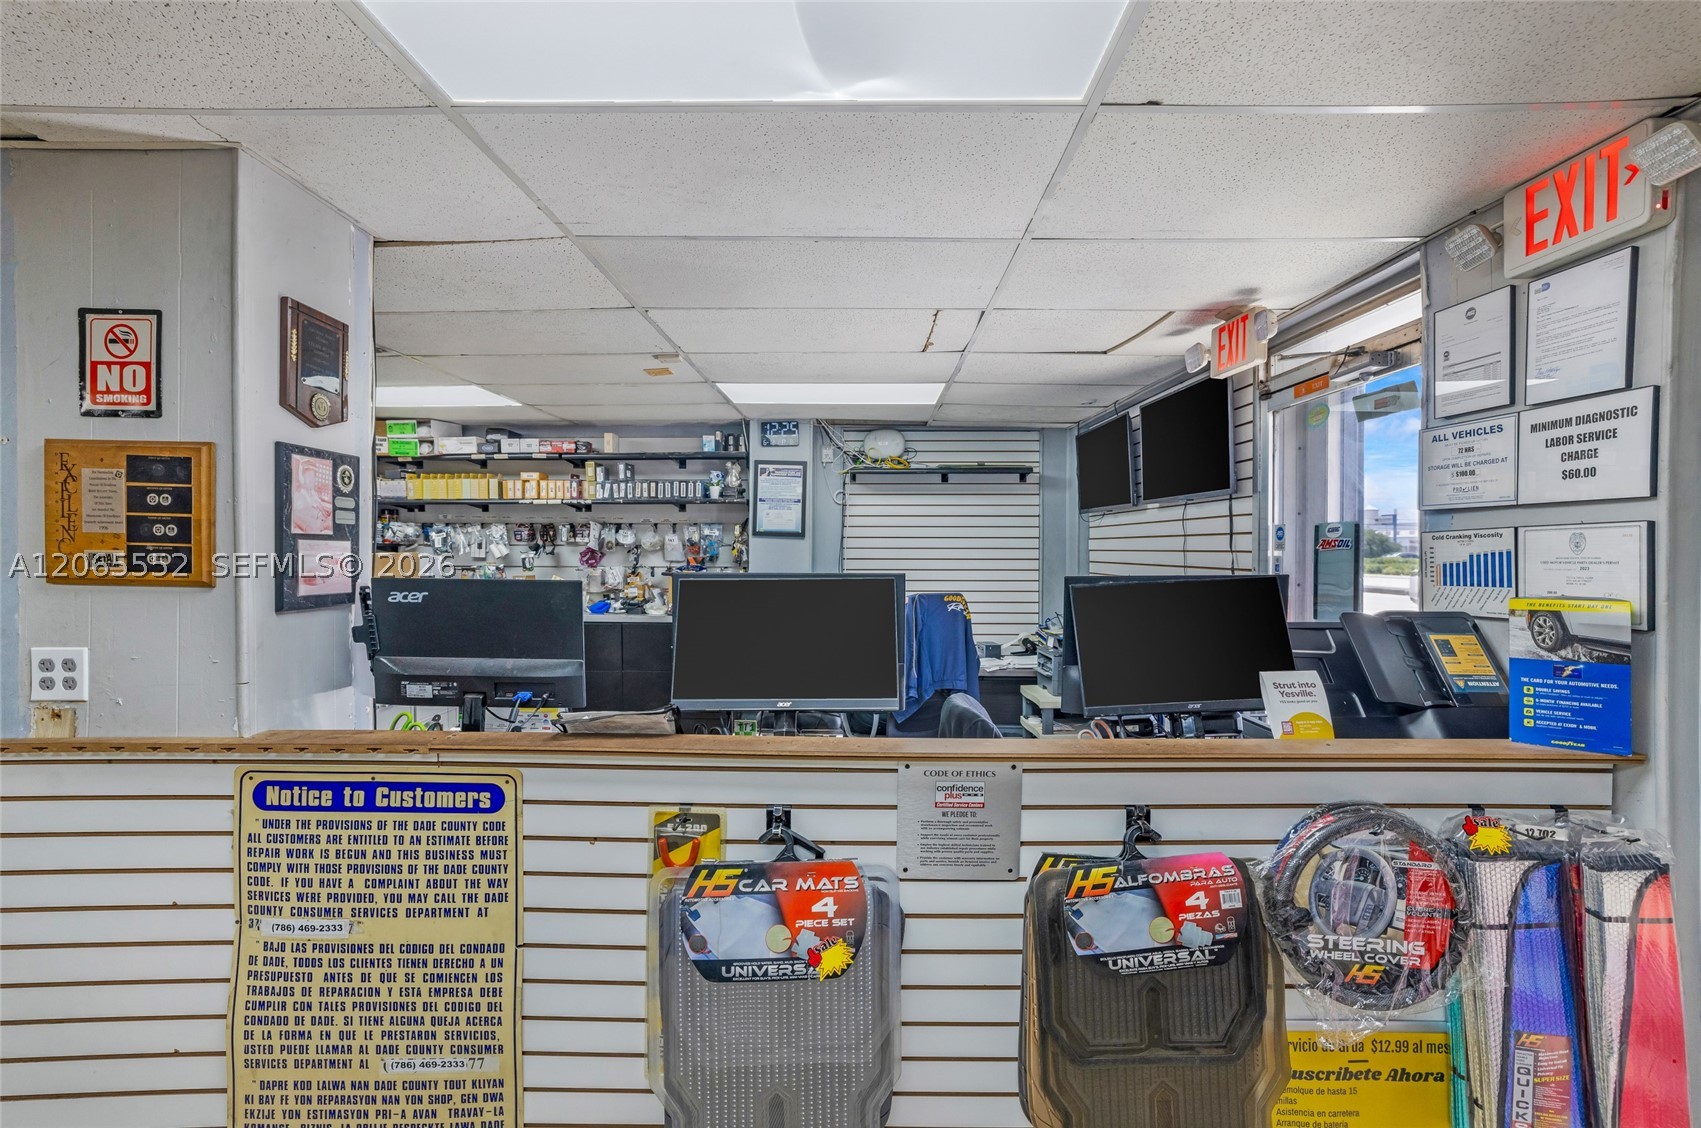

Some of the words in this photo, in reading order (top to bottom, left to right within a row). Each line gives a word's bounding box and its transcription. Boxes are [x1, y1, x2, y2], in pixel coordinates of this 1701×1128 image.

[1525, 135, 1629, 257] EXIT
[1217, 313, 1249, 372] EXIT
[97, 363, 147, 392] NO
[95, 394, 147, 404] SMOKING
[1530, 417, 1573, 434] MINIMUM
[1575, 405, 1639, 427] DIAGNOSTIC
[1431, 435, 1449, 443] ALL
[1452, 424, 1504, 440] VEHICLES
[1545, 436, 1575, 449] LABOR
[1576, 428, 1618, 446] SERVICE
[1560, 448, 1599, 463] CHARGE
[1427, 463, 1450, 471] STORAGE
[1464, 460, 1472, 468] BE
[1472, 458, 1500, 466] CHARGED
[1455, 469, 1476, 477] $100.00
[1561, 466, 1597, 481] $60.00
[1445, 533, 1472, 541] Cranking
[1473, 531, 1503, 539] Viscosity
[1317, 538, 1351, 550] AMSOIL
[387, 591, 429, 603] acer
[1272, 681, 1297, 690] Strut
[1297, 681, 1317, 689] into
[1568, 680, 1600, 688] AUTOMOTIVE
[1278, 690, 1317, 698] Yesville.
[1556, 699, 1580, 707] FINANCING
[1580, 701, 1603, 709] AVAILABLE
[965, 770, 997, 778] ETHICS
[936, 783, 984, 792] confidence
[265, 785, 332, 807] Notice
[344, 786, 365, 808] to
[376, 786, 491, 809] Customers
[944, 792, 963, 801] plus
[262, 818, 292, 830] UNDER
[296, 818, 312, 830] THE
[316, 818, 373, 831] PROVISIONS
[376, 819, 388, 831] OF
[392, 819, 409, 831] THE
[413, 820, 438, 831] DADE
[441, 820, 478, 832] COUNTY
[482, 820, 506, 832] CODE
[1472, 817, 1500, 828] sale
[247, 832, 262, 845] ALL
[266, 833, 321, 845] CUSTOMERS
[326, 833, 342, 845] ARE
[347, 833, 389, 846] ENTITLED
[393, 834, 405, 846] TO
[409, 834, 422, 846] AN
[426, 834, 471, 846] ESTIMATE
[475, 835, 509, 847] BEFORE
[246, 847, 281, 859] REPAIR
[286, 848, 314, 859] WORK
[320, 848, 330, 860] IS
[335, 848, 367, 860] BEGUN
[372, 848, 392, 860] AND
[397, 849, 420, 860] THIS
[425, 849, 475, 861] BUSINESS
[480, 849, 508, 861] MUST
[1392, 860, 1433, 868] STANDARD
[687, 868, 743, 898] HS
[738, 878, 789, 892] CAR
[795, 875, 860, 892] MATS
[1065, 865, 1119, 899] HS
[1113, 864, 1236, 889] ALFOMBRAS
[1189, 879, 1214, 887] PARA
[1215, 876, 1238, 885] AUTO
[810, 897, 839, 918] 4
[1185, 891, 1209, 910] 4
[1178, 909, 1221, 921] PIEZAS
[271, 924, 296, 934] (786)
[298, 924, 344, 933] 469-2333
[795, 918, 829, 928] PIECE
[832, 918, 855, 927] SET
[813, 936, 838, 954] sale
[1306, 934, 1426, 955] STEERING
[1108, 948, 1216, 971] UNIVERSAL
[1308, 949, 1361, 962] WHEEL
[1364, 953, 1422, 966] COVER
[721, 963, 820, 979] UNIVERSA
[1343, 963, 1386, 985] HS
[1288, 1037, 1318, 1053] rvicio
[1371, 1038, 1409, 1054] $12.99
[1412, 1040, 1423, 1053] al
[1426, 1043, 1450, 1054] mes
[1516, 1033, 1545, 1047] HS
[390, 1060, 416, 1070] (786)
[418, 1060, 465, 1069] 469-2333
[1290, 1066, 1382, 1082] uscribete
[1384, 1067, 1445, 1083] Ahora
[1282, 1086, 1314, 1096] emolque
[1315, 1086, 1326, 1095] de
[1327, 1087, 1347, 1095] hasta
[1348, 1087, 1358, 1095] 15
[1276, 1107, 1315, 1117] Asistencia
[1327, 1108, 1360, 1117] carretera
[1276, 1119, 1310, 1128] Arranque
[1312, 1119, 1322, 1128] de
